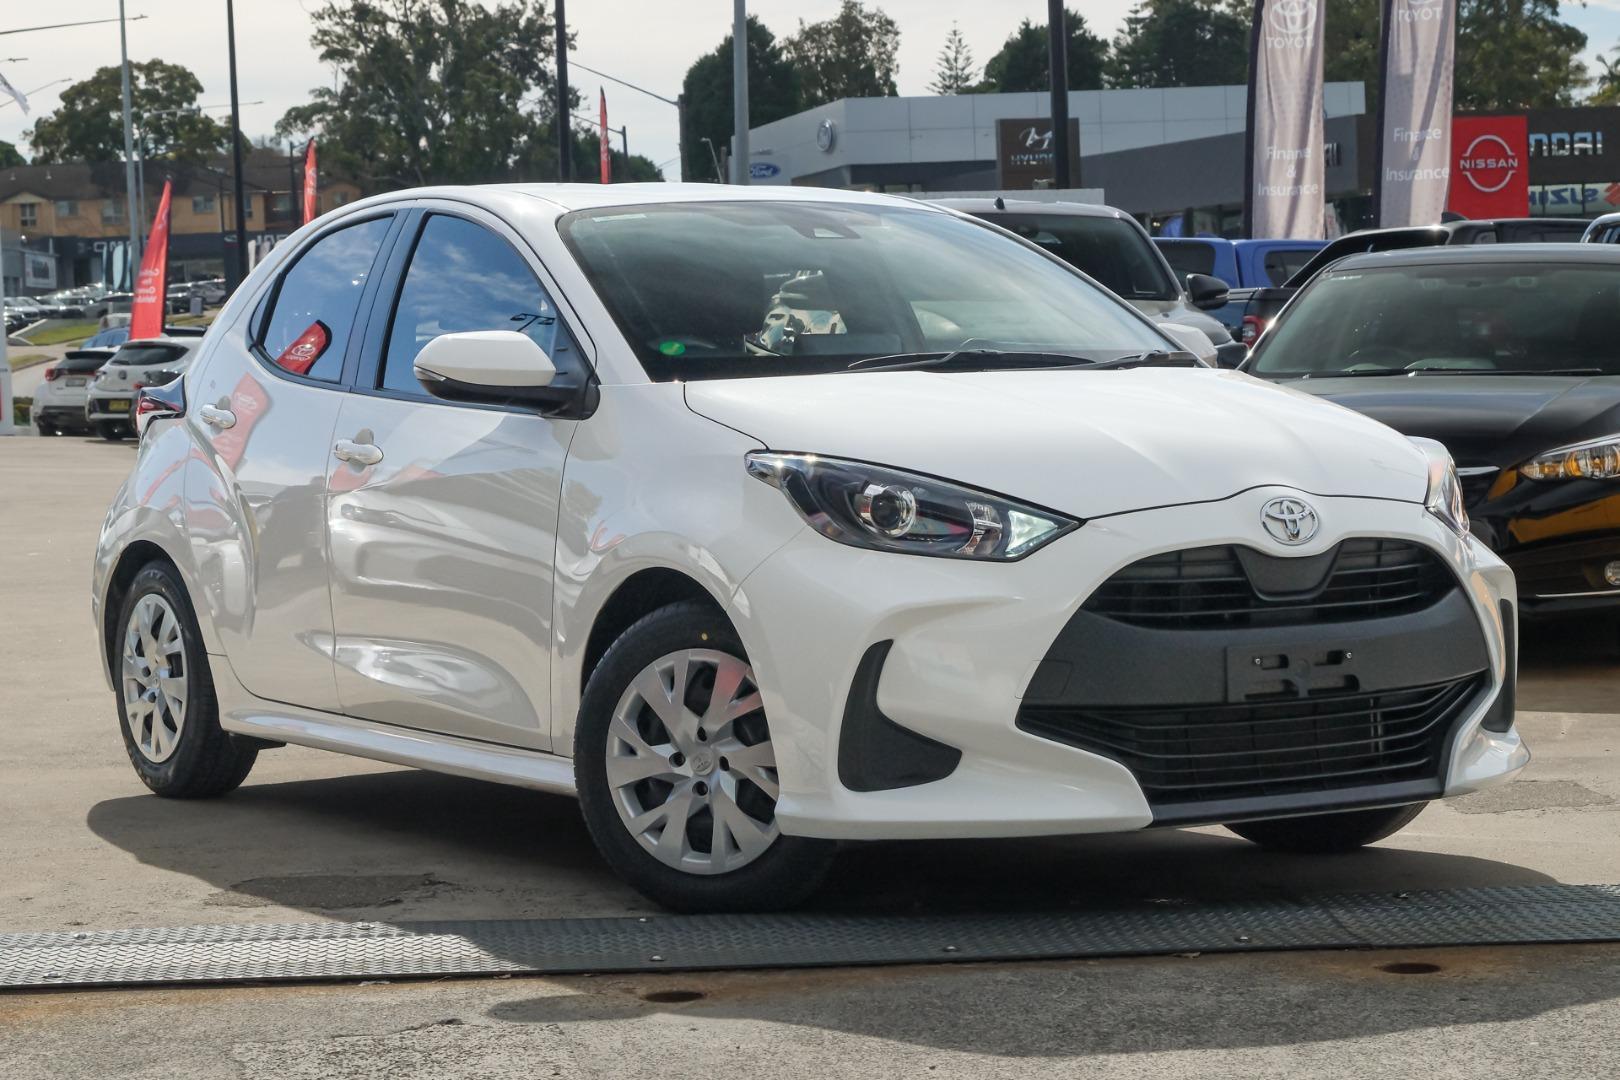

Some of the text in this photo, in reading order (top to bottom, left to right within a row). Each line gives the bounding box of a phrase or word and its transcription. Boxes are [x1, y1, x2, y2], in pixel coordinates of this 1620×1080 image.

[1398, 7, 1443, 23] TOYOT
[1266, 36, 1314, 49] TOYOT
[1459, 158, 1519, 170] NISSAN
